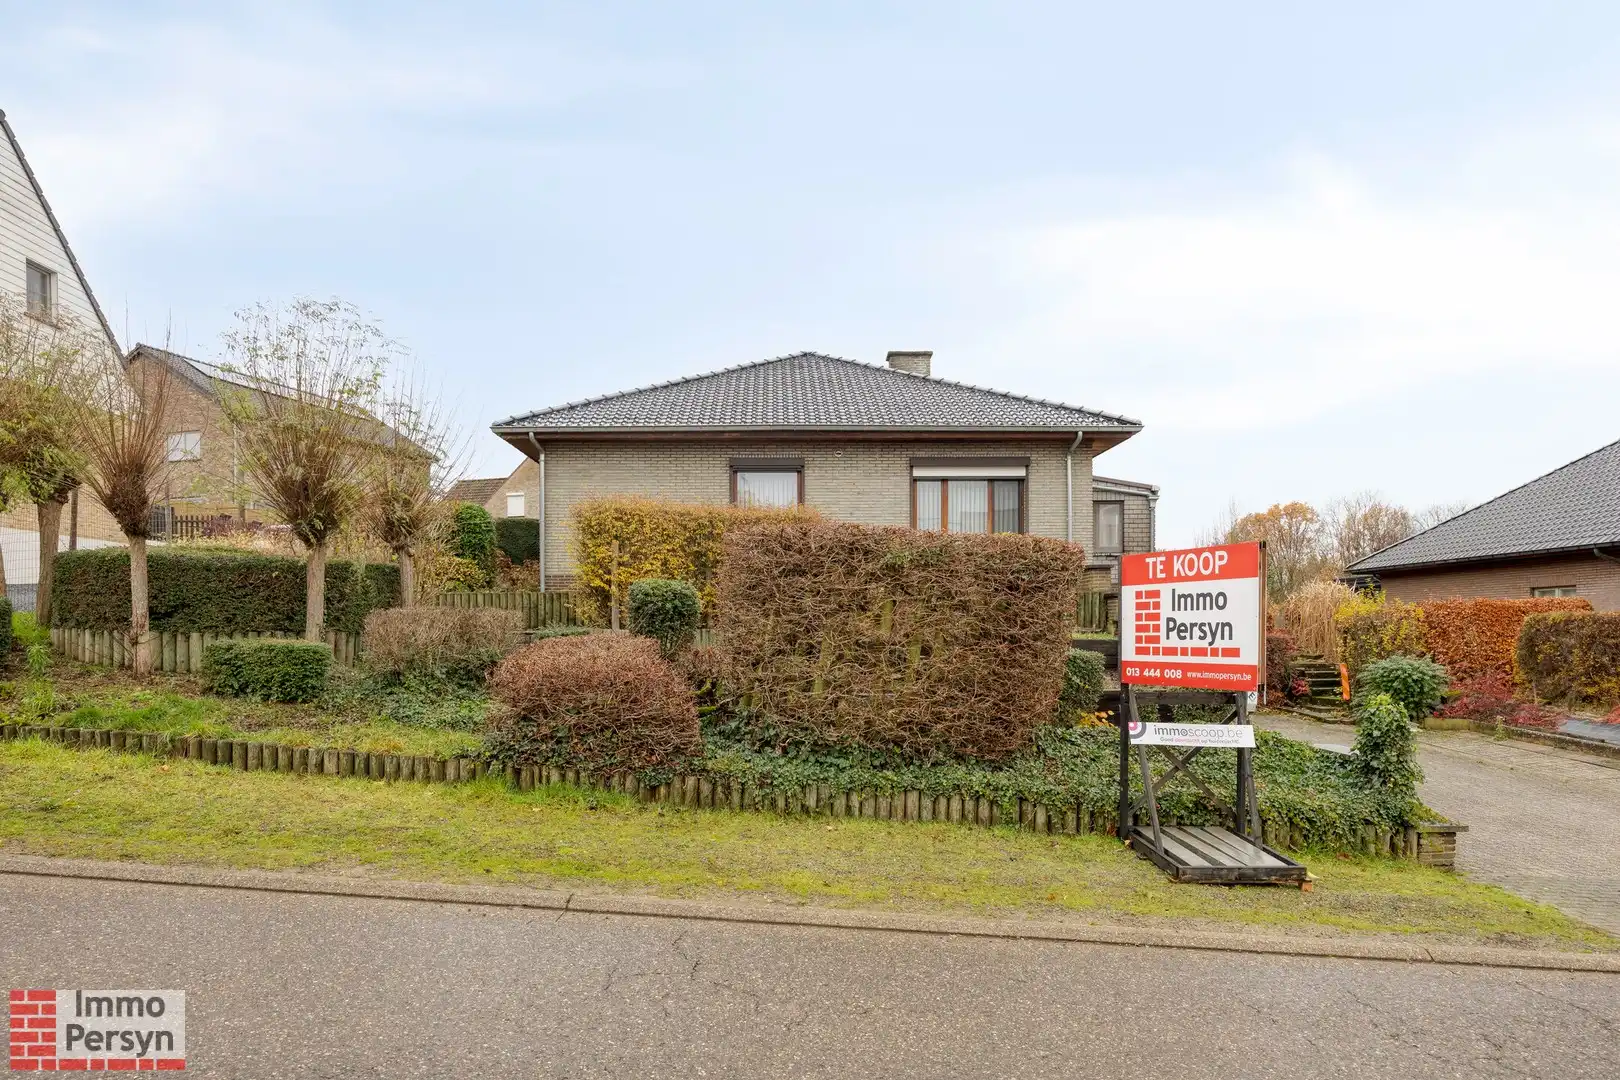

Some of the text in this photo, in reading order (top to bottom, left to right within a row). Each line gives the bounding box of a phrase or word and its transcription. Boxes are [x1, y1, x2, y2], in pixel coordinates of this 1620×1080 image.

[1145, 551, 1228, 579] TE KOOP
[1171, 588, 1227, 612] Immo
[1166, 617, 1233, 646] Persyn
[1126, 667, 1182, 678] 013 444 008
[1187, 671, 1252, 681] www.immopersyn.be
[1154, 725, 1243, 740] immoscoop.be
